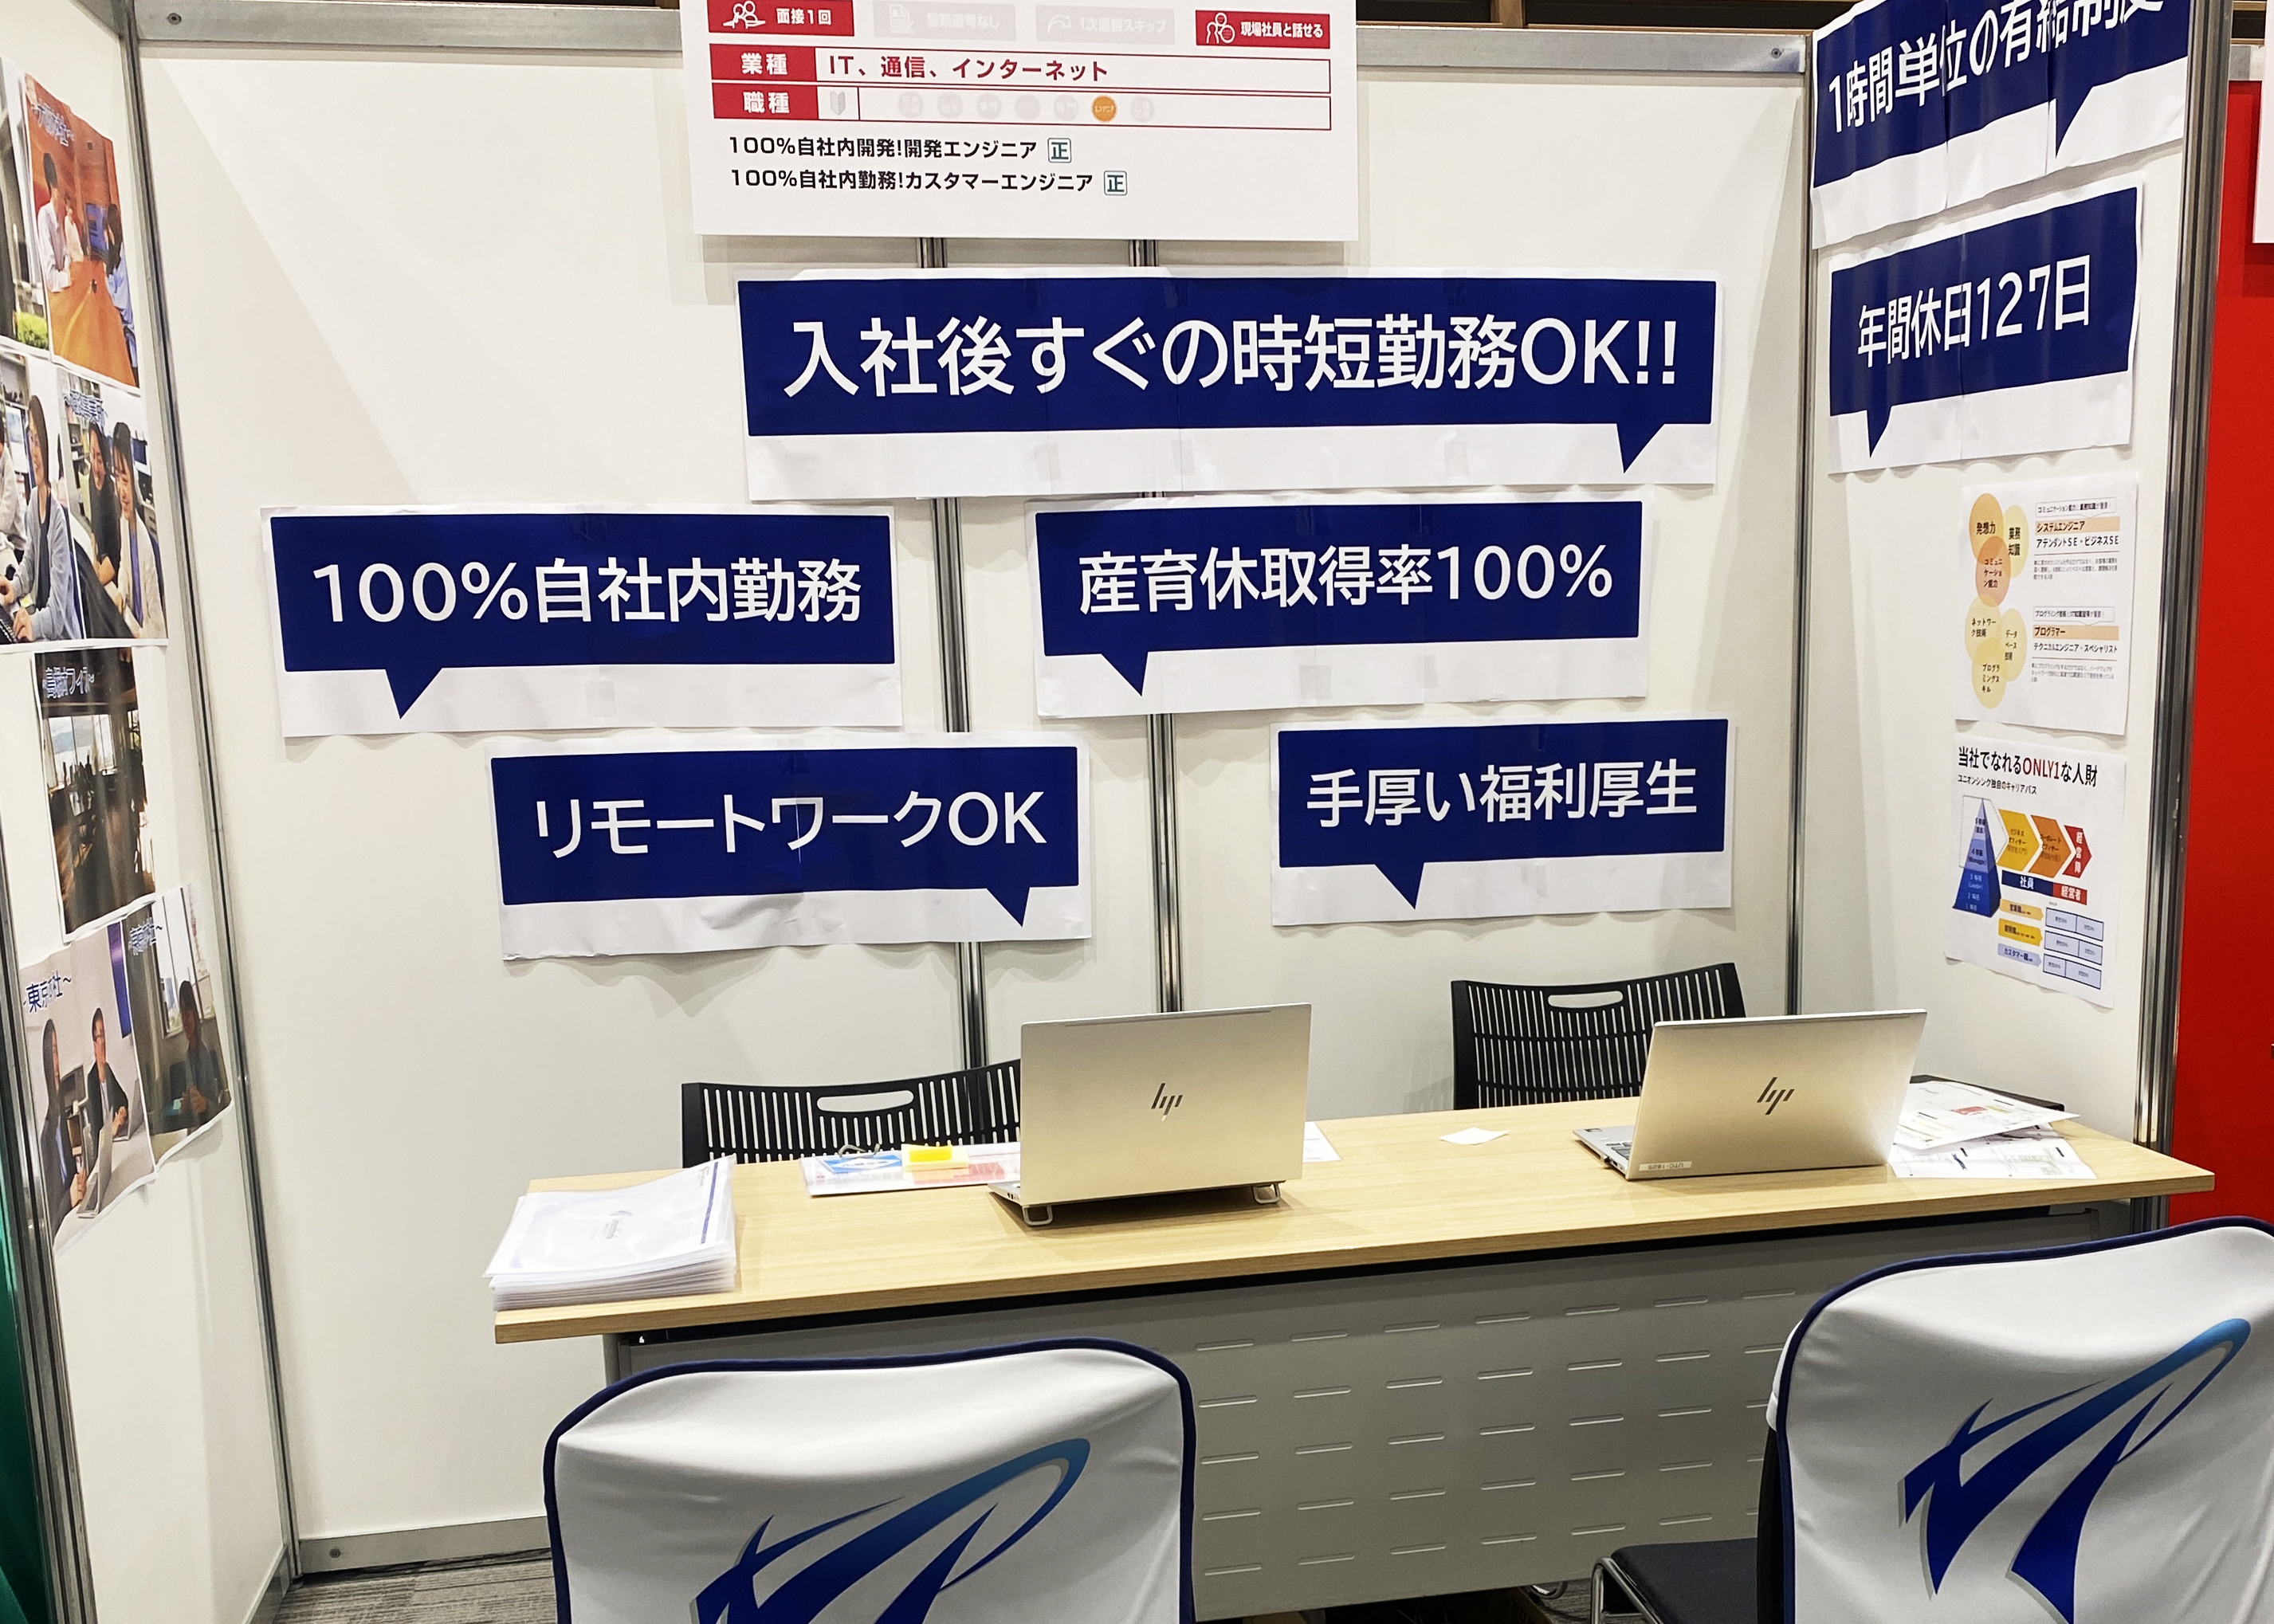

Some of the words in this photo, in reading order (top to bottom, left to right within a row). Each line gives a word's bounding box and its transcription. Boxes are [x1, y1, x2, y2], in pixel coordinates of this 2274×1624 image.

[776, 8, 831, 25] 面接1回
[1241, 22, 1323, 38] 現場社員と話せる
[741, 53, 787, 75] 業種
[830, 54, 1107, 81] IT、通信、インターネット
[744, 92, 789, 113] 職種
[730, 137, 1036, 159] 100%自社内開発!開発エンジニア
[732, 170, 1092, 191] 100%自社内勤務!カスタマーエンジニア
[1858, 255, 2090, 367] 年間休日127日
[784, 314, 1677, 397] 入社後すぐの時短勤務OK!!
[1976, 521, 1995, 535] 発想力
[2036, 520, 2085, 533] システムエンジニア
[313, 557, 861, 622] 100%自社内勤務
[1079, 544, 1612, 614] 産育休取得率100%
[1971, 618, 1996, 626] ネットワー
[2034, 626, 2066, 637] プログラマー
[1958, 746, 2098, 787] 当社でなれるONLY1な人財
[1307, 759, 1696, 827] 手厚い福利厚生
[537, 791, 1047, 858] リモートワークOK
[2020, 876, 2034, 889] 社員
[2060, 885, 2082, 901] 経営者
